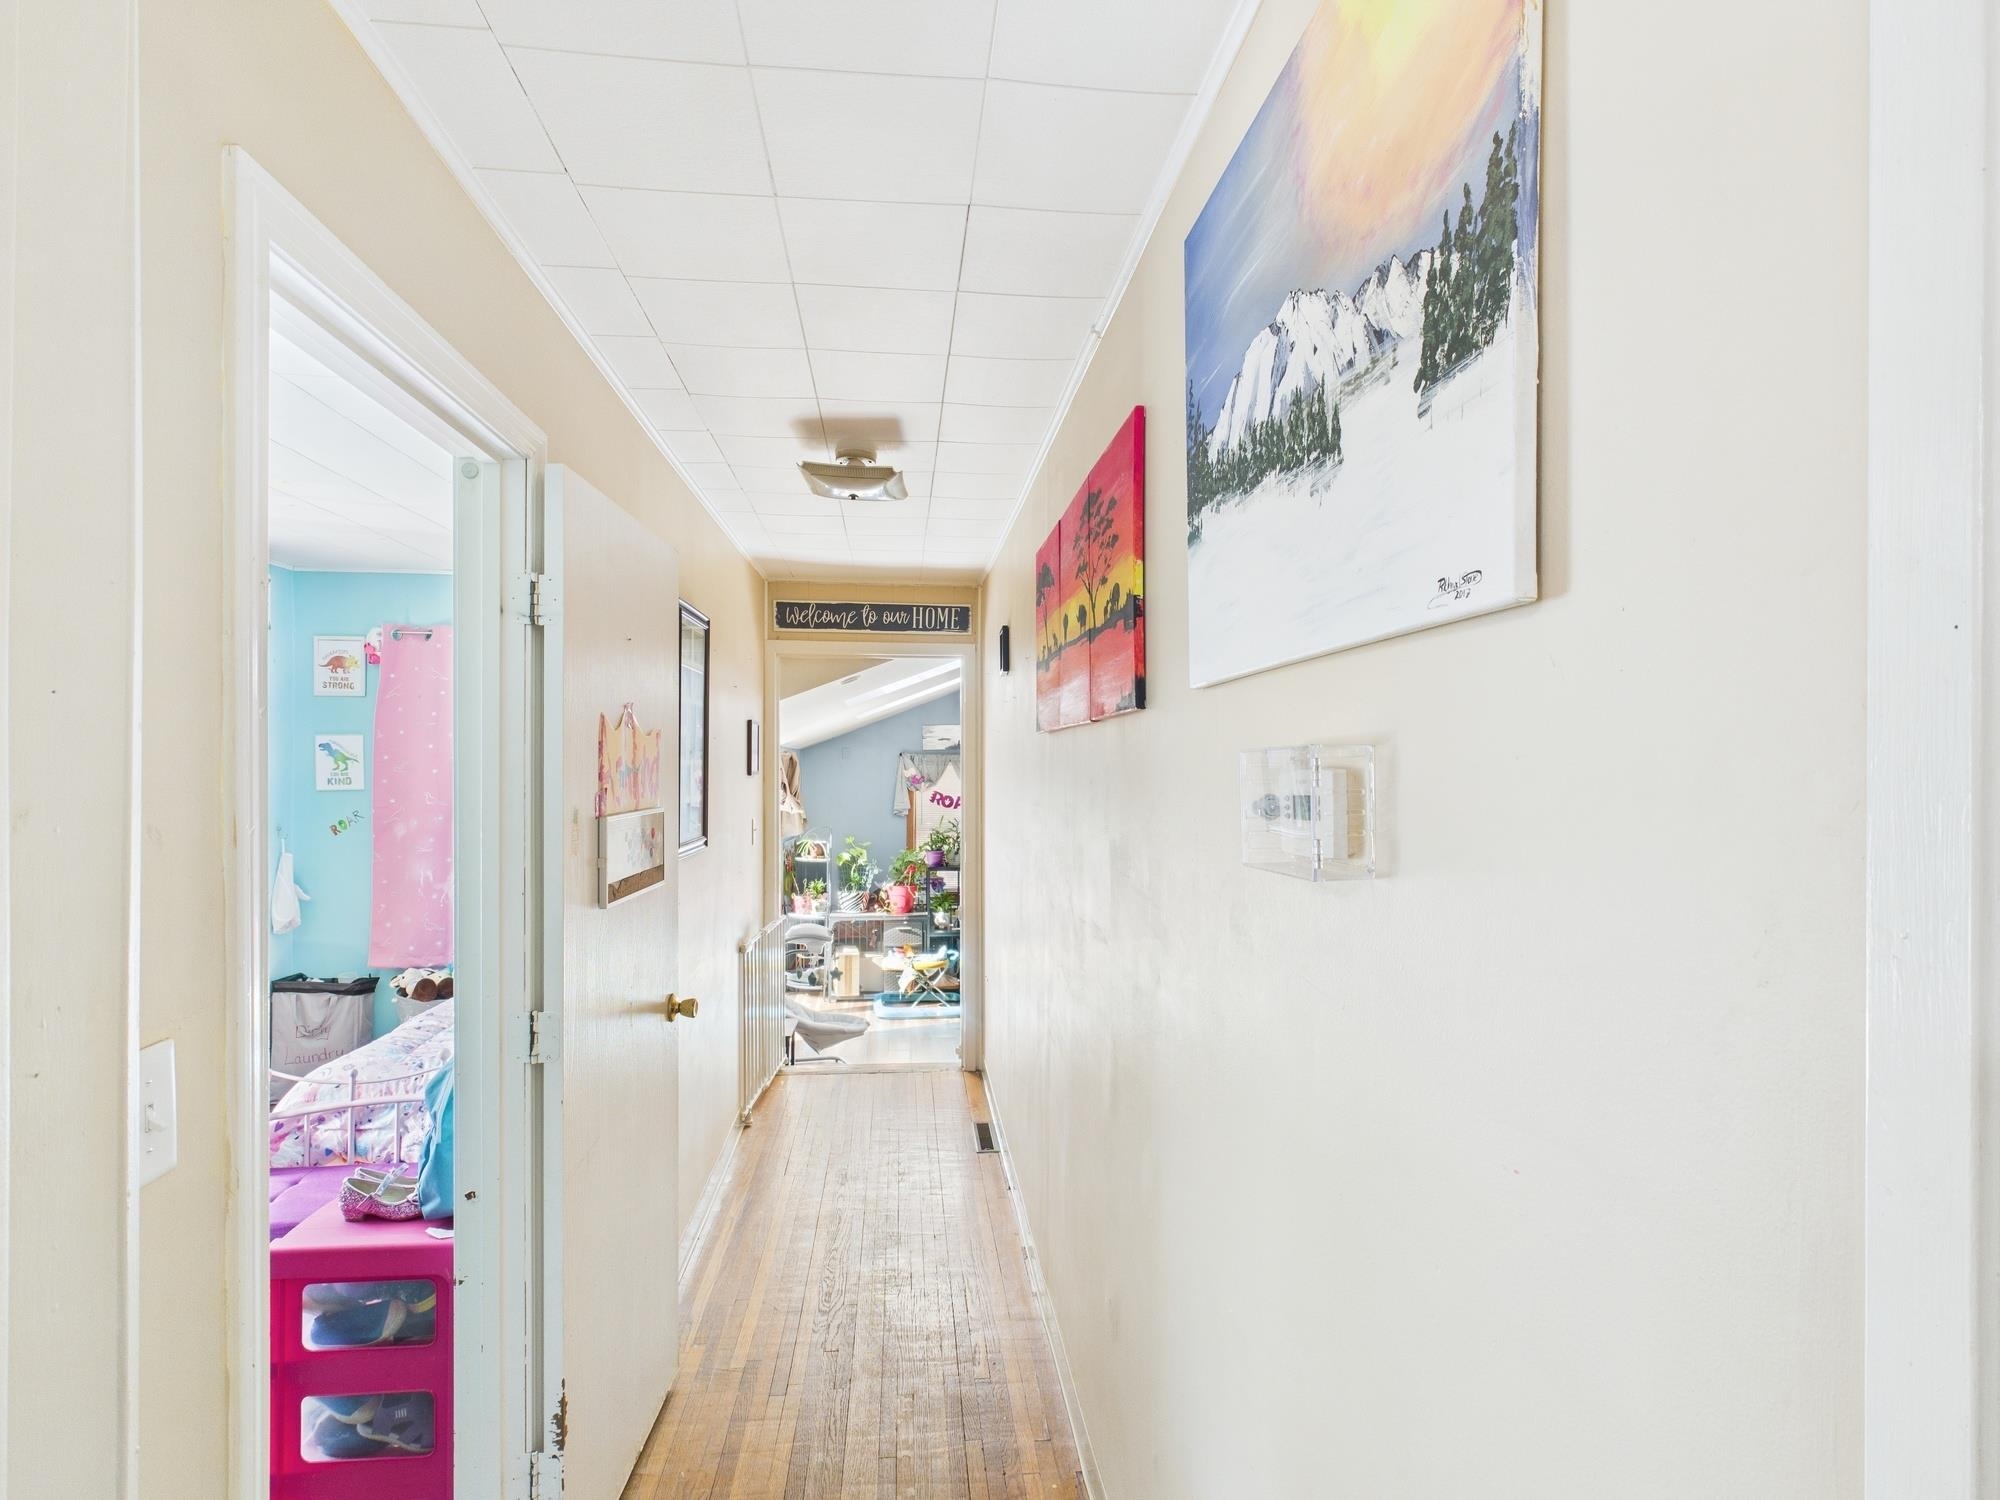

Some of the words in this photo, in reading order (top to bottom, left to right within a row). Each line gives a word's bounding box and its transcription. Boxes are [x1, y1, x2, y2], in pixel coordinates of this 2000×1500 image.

[785, 603, 858, 628] welcome
[860, 604, 879, 627] to
[882, 608, 910, 624] our
[912, 606, 961, 630] HOME
[321, 681, 355, 690] STRONG
[327, 776, 352, 786] KIND
[329, 809, 367, 836] ROAR
